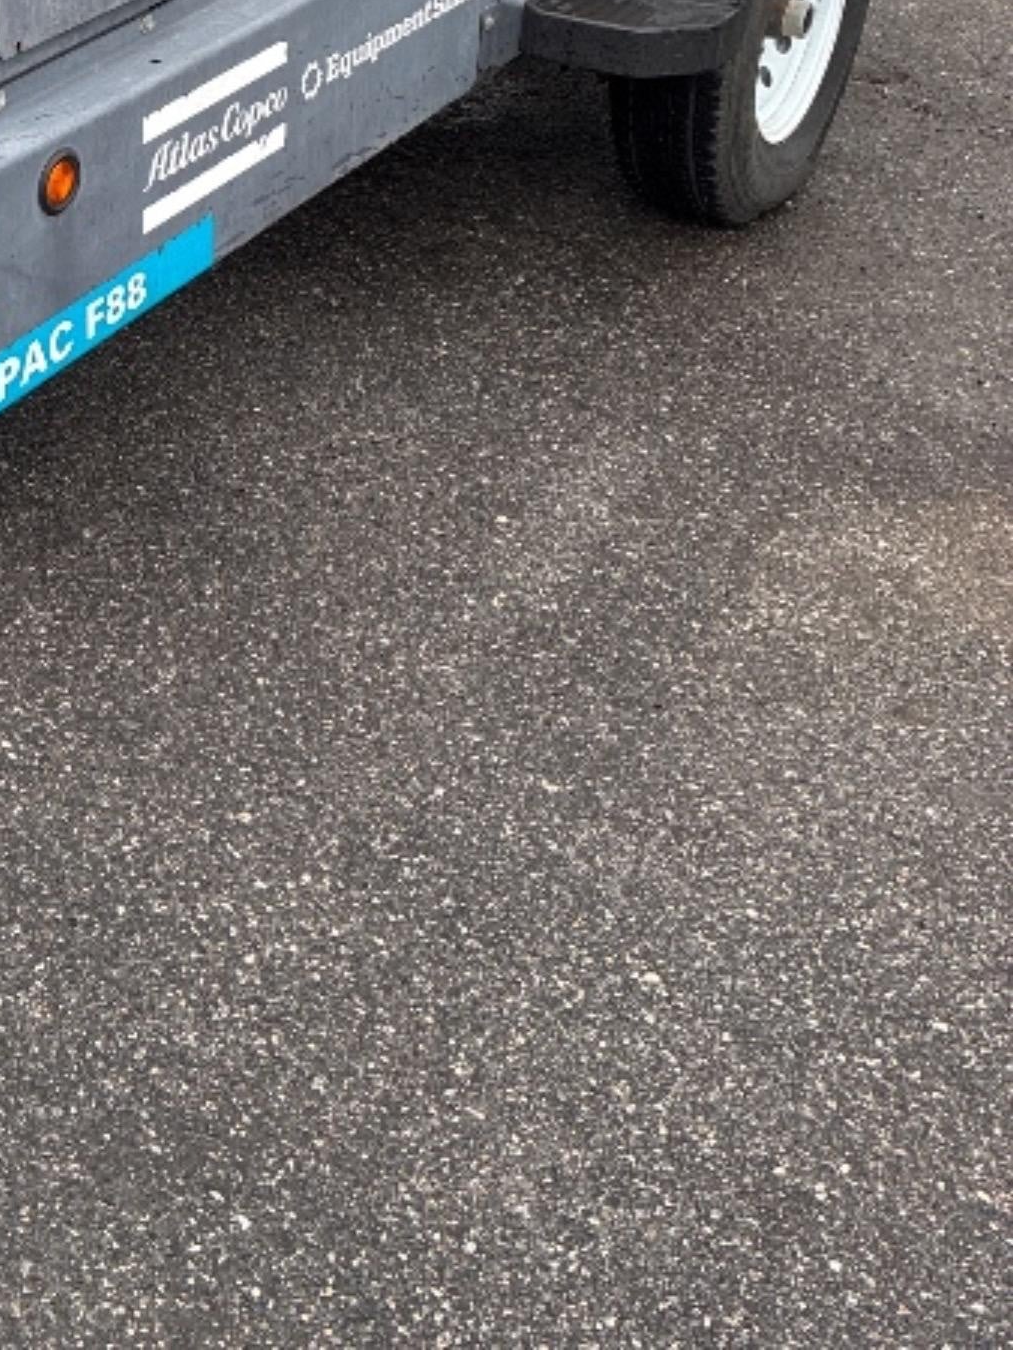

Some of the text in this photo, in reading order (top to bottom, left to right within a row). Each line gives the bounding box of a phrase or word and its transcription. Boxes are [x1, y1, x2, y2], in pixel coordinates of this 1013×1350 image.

[142, 86, 289, 193] Atlas Copco
[85, 272, 147, 340] F88
